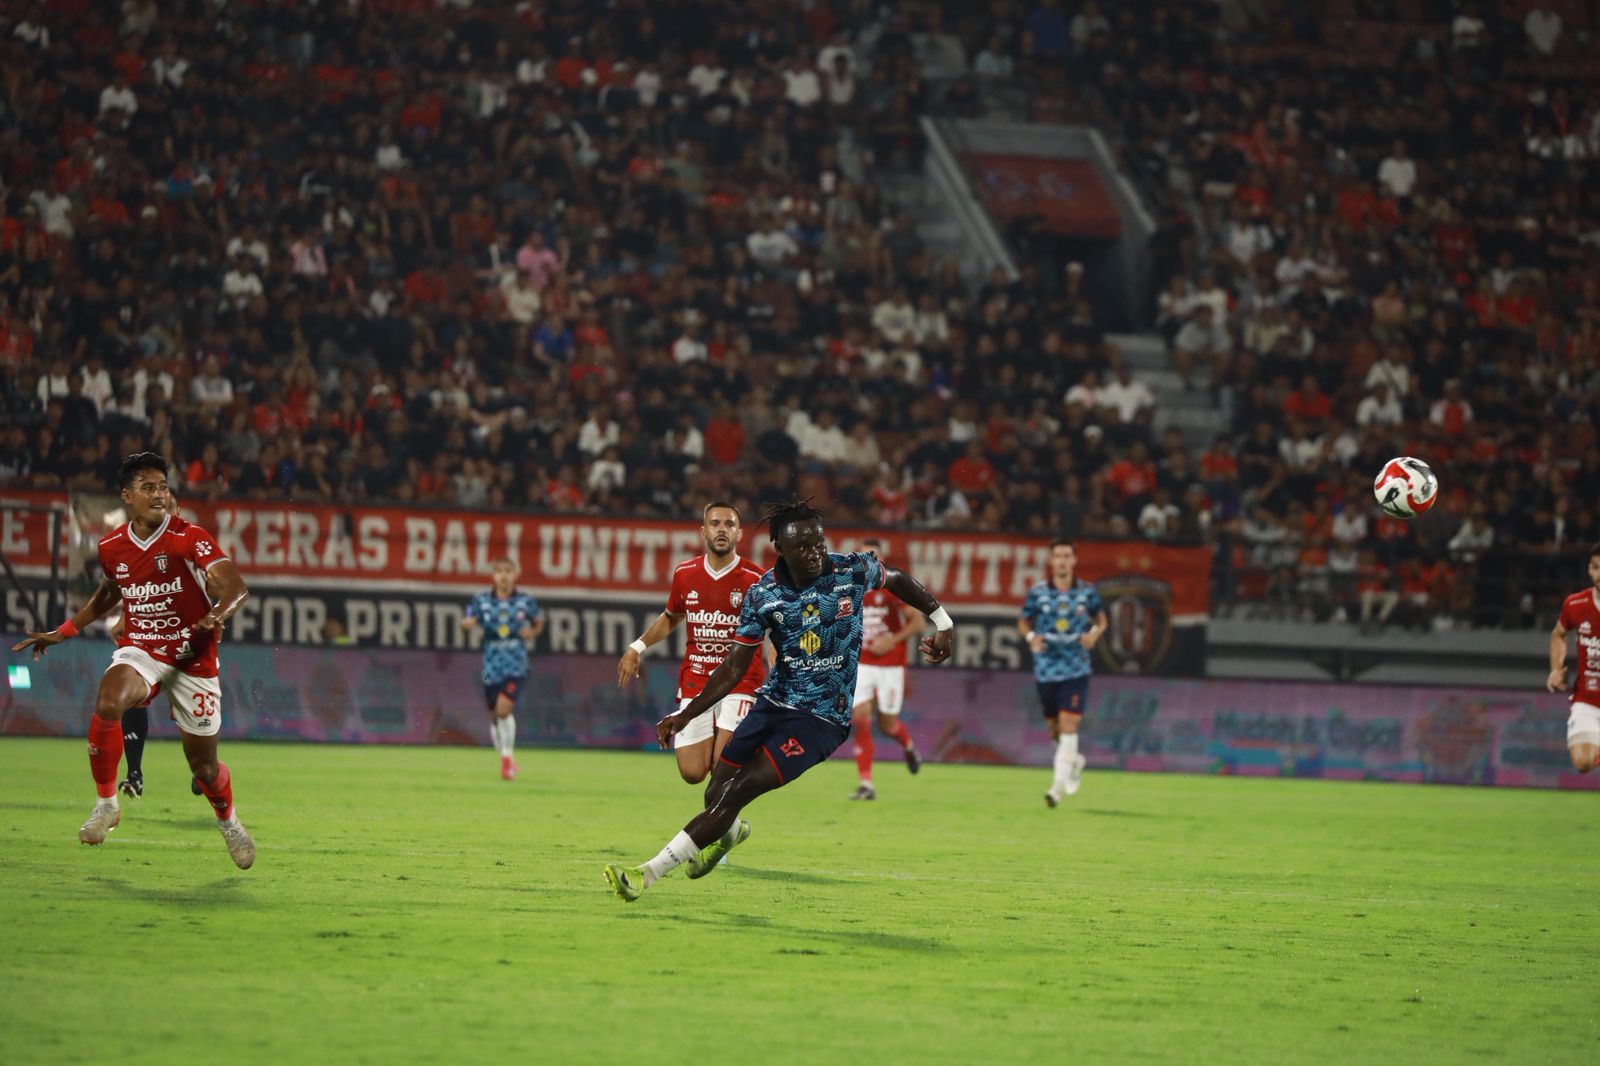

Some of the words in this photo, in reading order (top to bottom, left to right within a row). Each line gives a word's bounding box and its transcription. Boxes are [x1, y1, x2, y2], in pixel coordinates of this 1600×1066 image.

[216, 509, 390, 571] KERAS
[404, 517, 523, 575] BALI
[906, 540, 1048, 597] WITH
[118, 576, 183, 602] ndofood
[130, 616, 181, 632] oppo
